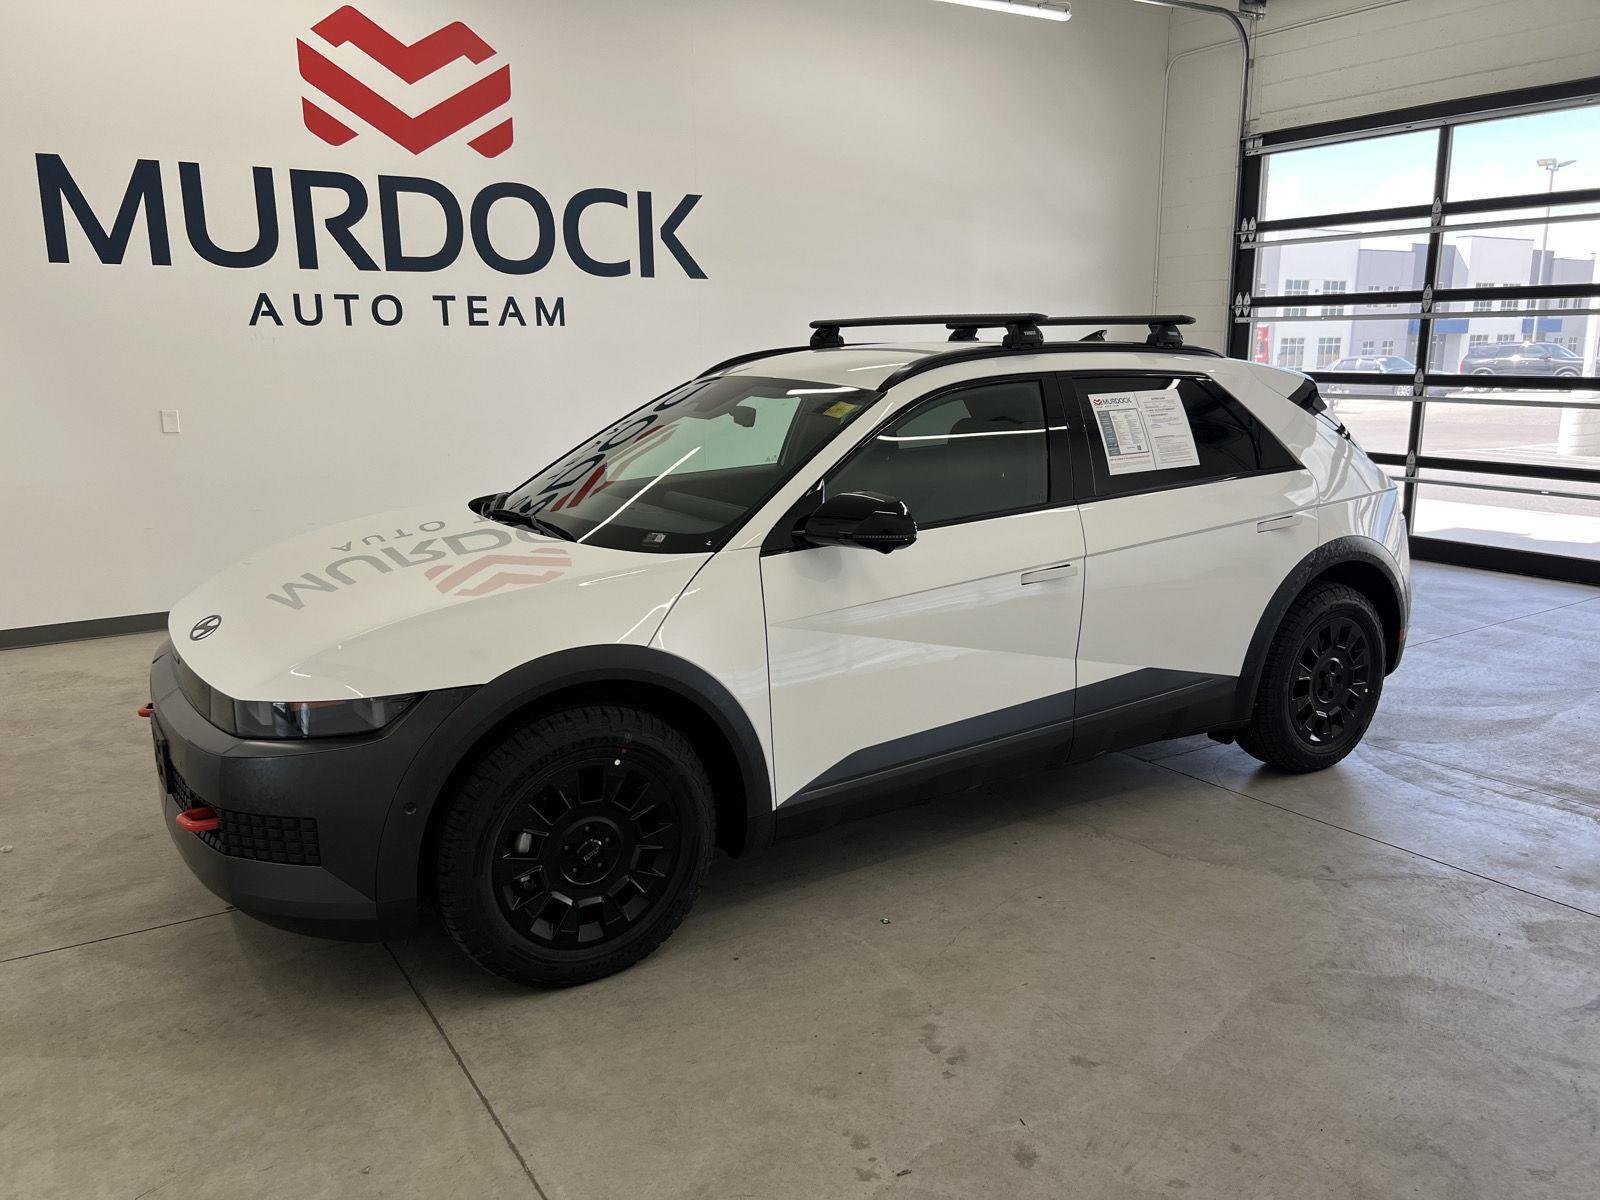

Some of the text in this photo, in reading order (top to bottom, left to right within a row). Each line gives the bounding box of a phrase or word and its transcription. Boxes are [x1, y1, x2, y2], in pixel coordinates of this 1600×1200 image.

[35, 152, 708, 280] MURDOCK
[249, 293, 566, 327] AUTO TEAM
